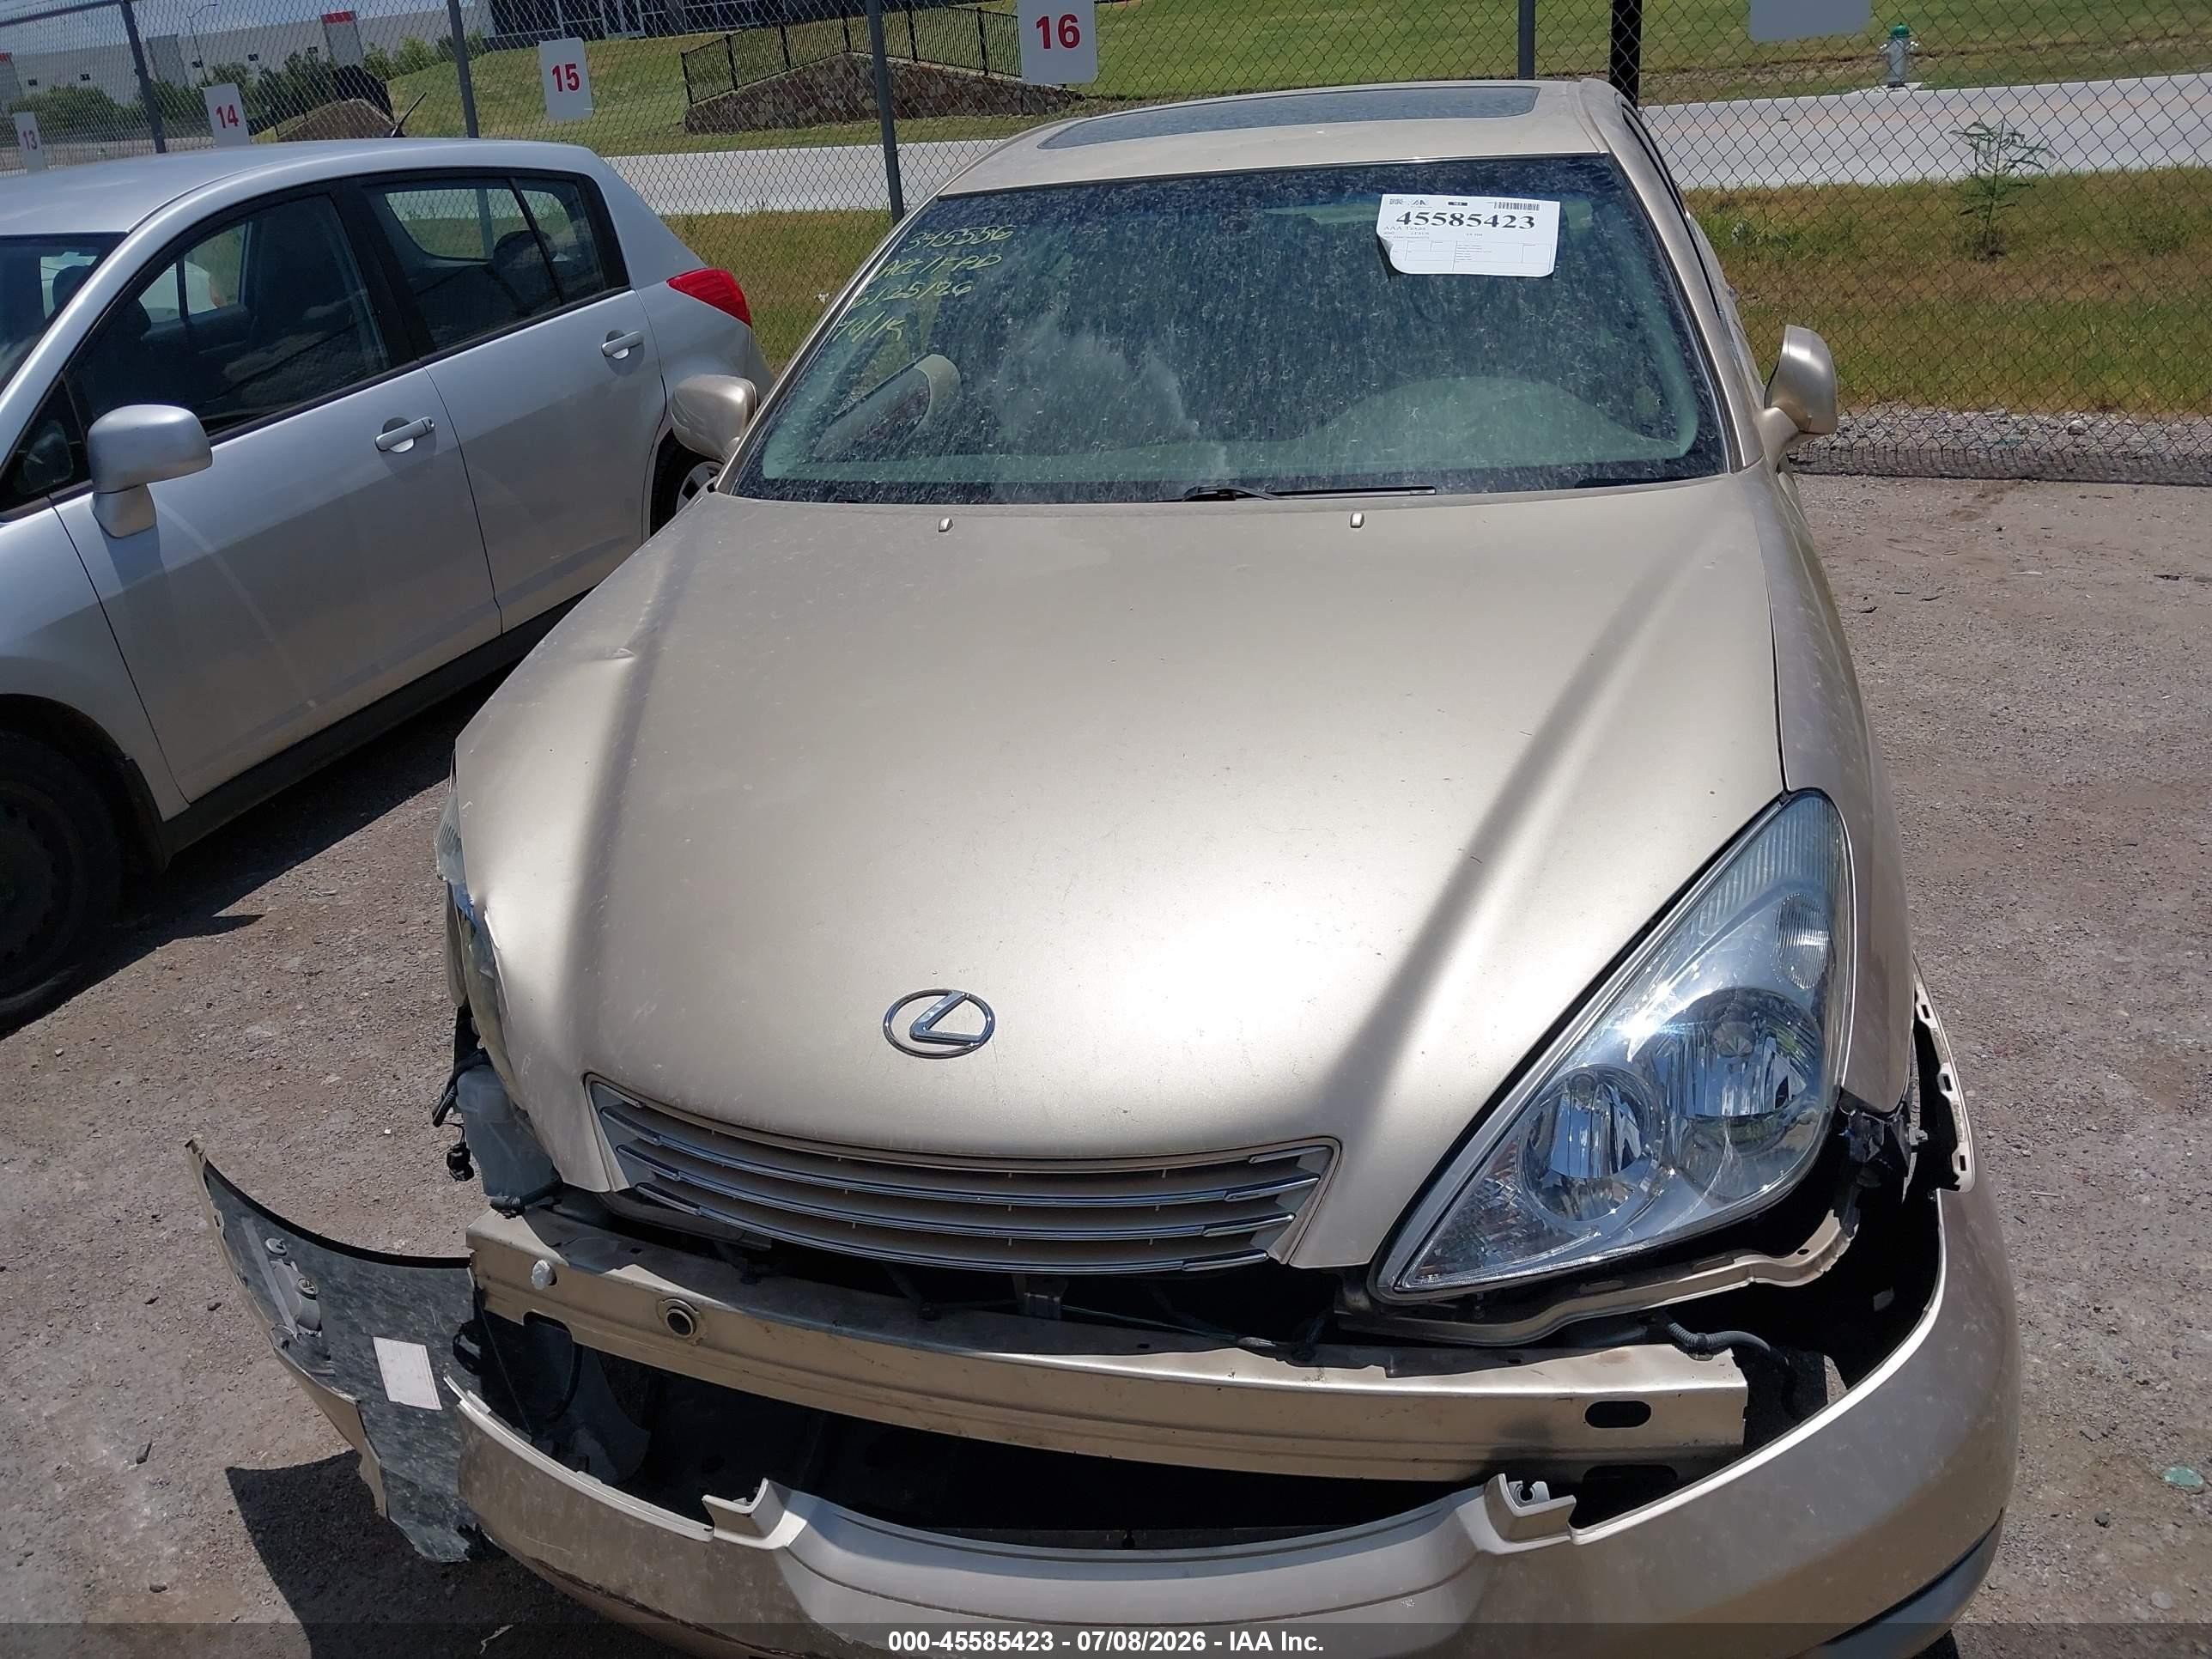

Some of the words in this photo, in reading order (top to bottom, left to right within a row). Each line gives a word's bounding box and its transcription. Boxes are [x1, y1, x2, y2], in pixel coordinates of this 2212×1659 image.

[1035, 13, 1081, 50] 16
[551, 63, 580, 93] 15
[216, 104, 240, 129] 14
[22, 130, 38, 150] 13
[1395, 211, 1536, 230] 45585423
